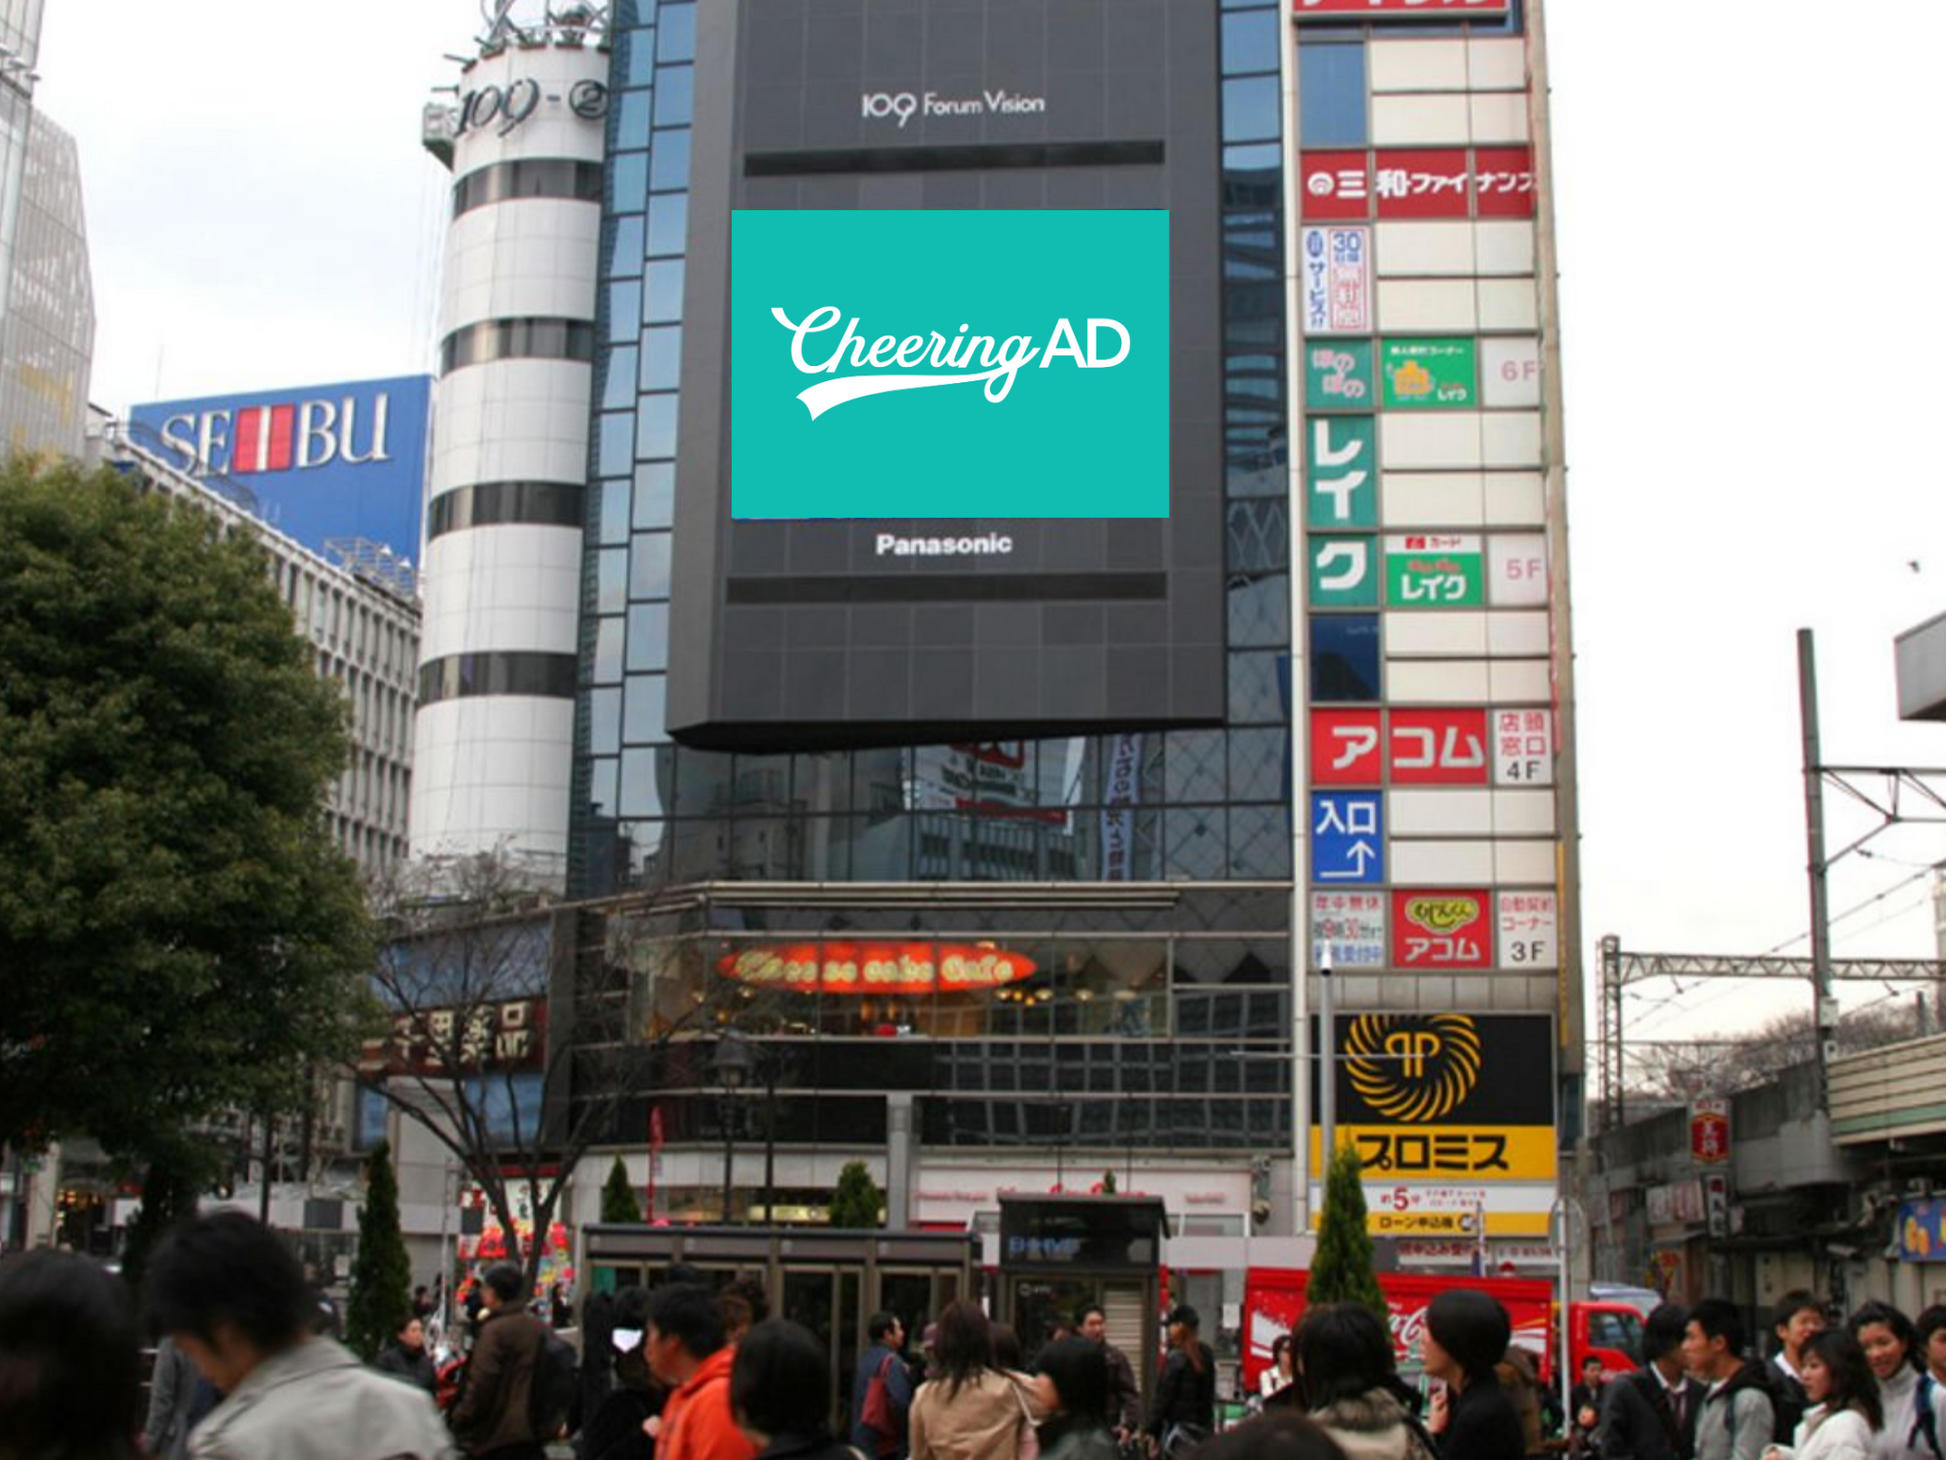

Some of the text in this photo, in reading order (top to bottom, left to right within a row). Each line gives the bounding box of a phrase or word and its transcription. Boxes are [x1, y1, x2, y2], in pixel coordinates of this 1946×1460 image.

[861, 89, 1046, 129] 109 Forum Vision
[160, 392, 391, 477] SEIBU
[876, 532, 1013, 556] Panasonic
[1505, 557, 1543, 580] 5F
[1401, 574, 1468, 600] レイク
[1332, 725, 1485, 770] アコム
[1506, 760, 1541, 781] 4F
[1315, 800, 1377, 835] 入口
[1405, 937, 1481, 962] アコム
[1511, 940, 1547, 962] 3F
[1355, 1133, 1510, 1171] プロミス
